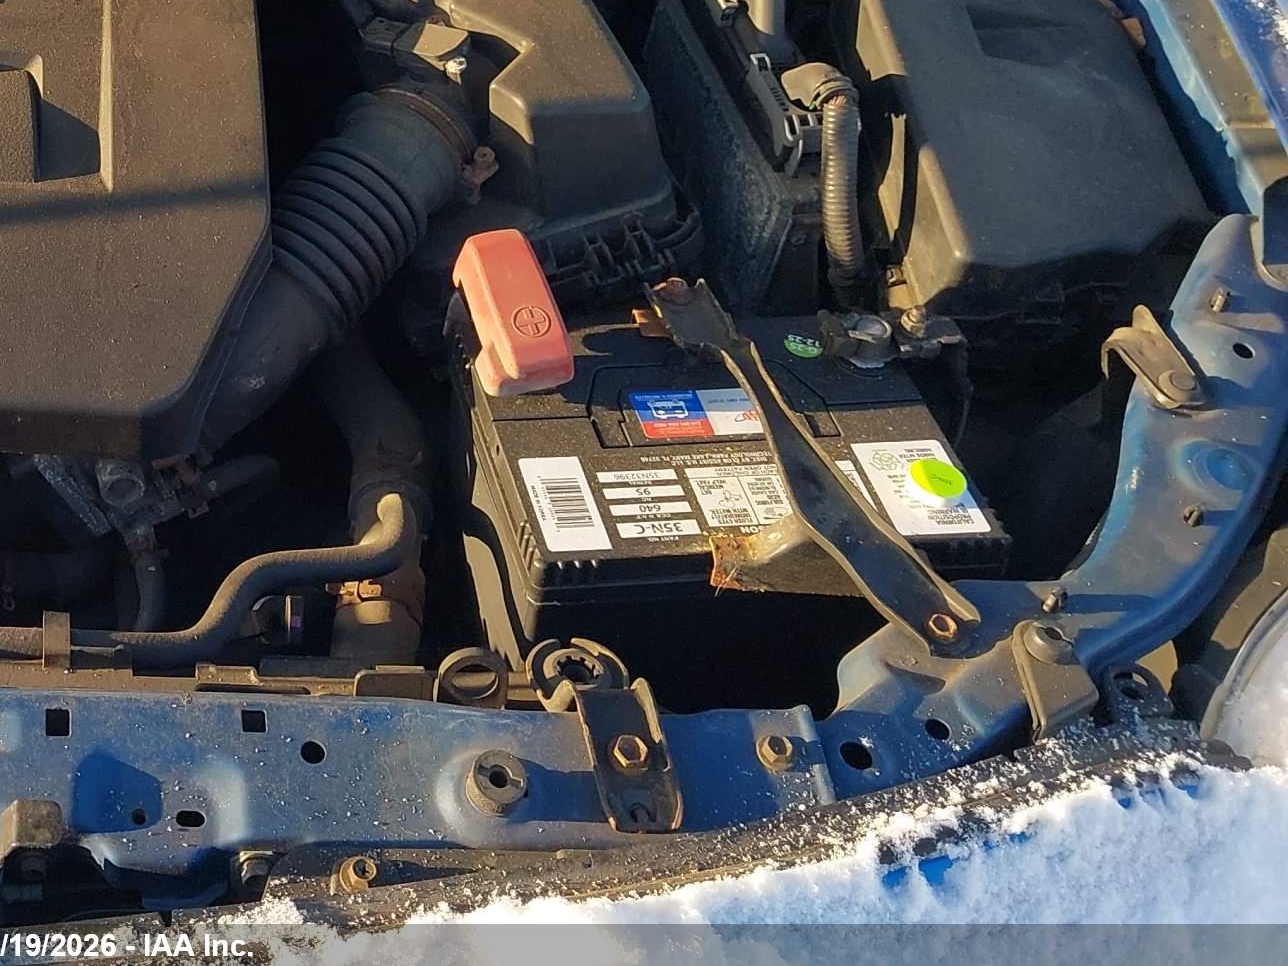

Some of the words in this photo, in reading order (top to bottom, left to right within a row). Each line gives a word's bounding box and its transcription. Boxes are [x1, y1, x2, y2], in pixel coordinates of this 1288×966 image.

[635, 487, 652, 496] 95
[639, 504, 662, 513] 640
[633, 522, 683, 535] 35N-C
